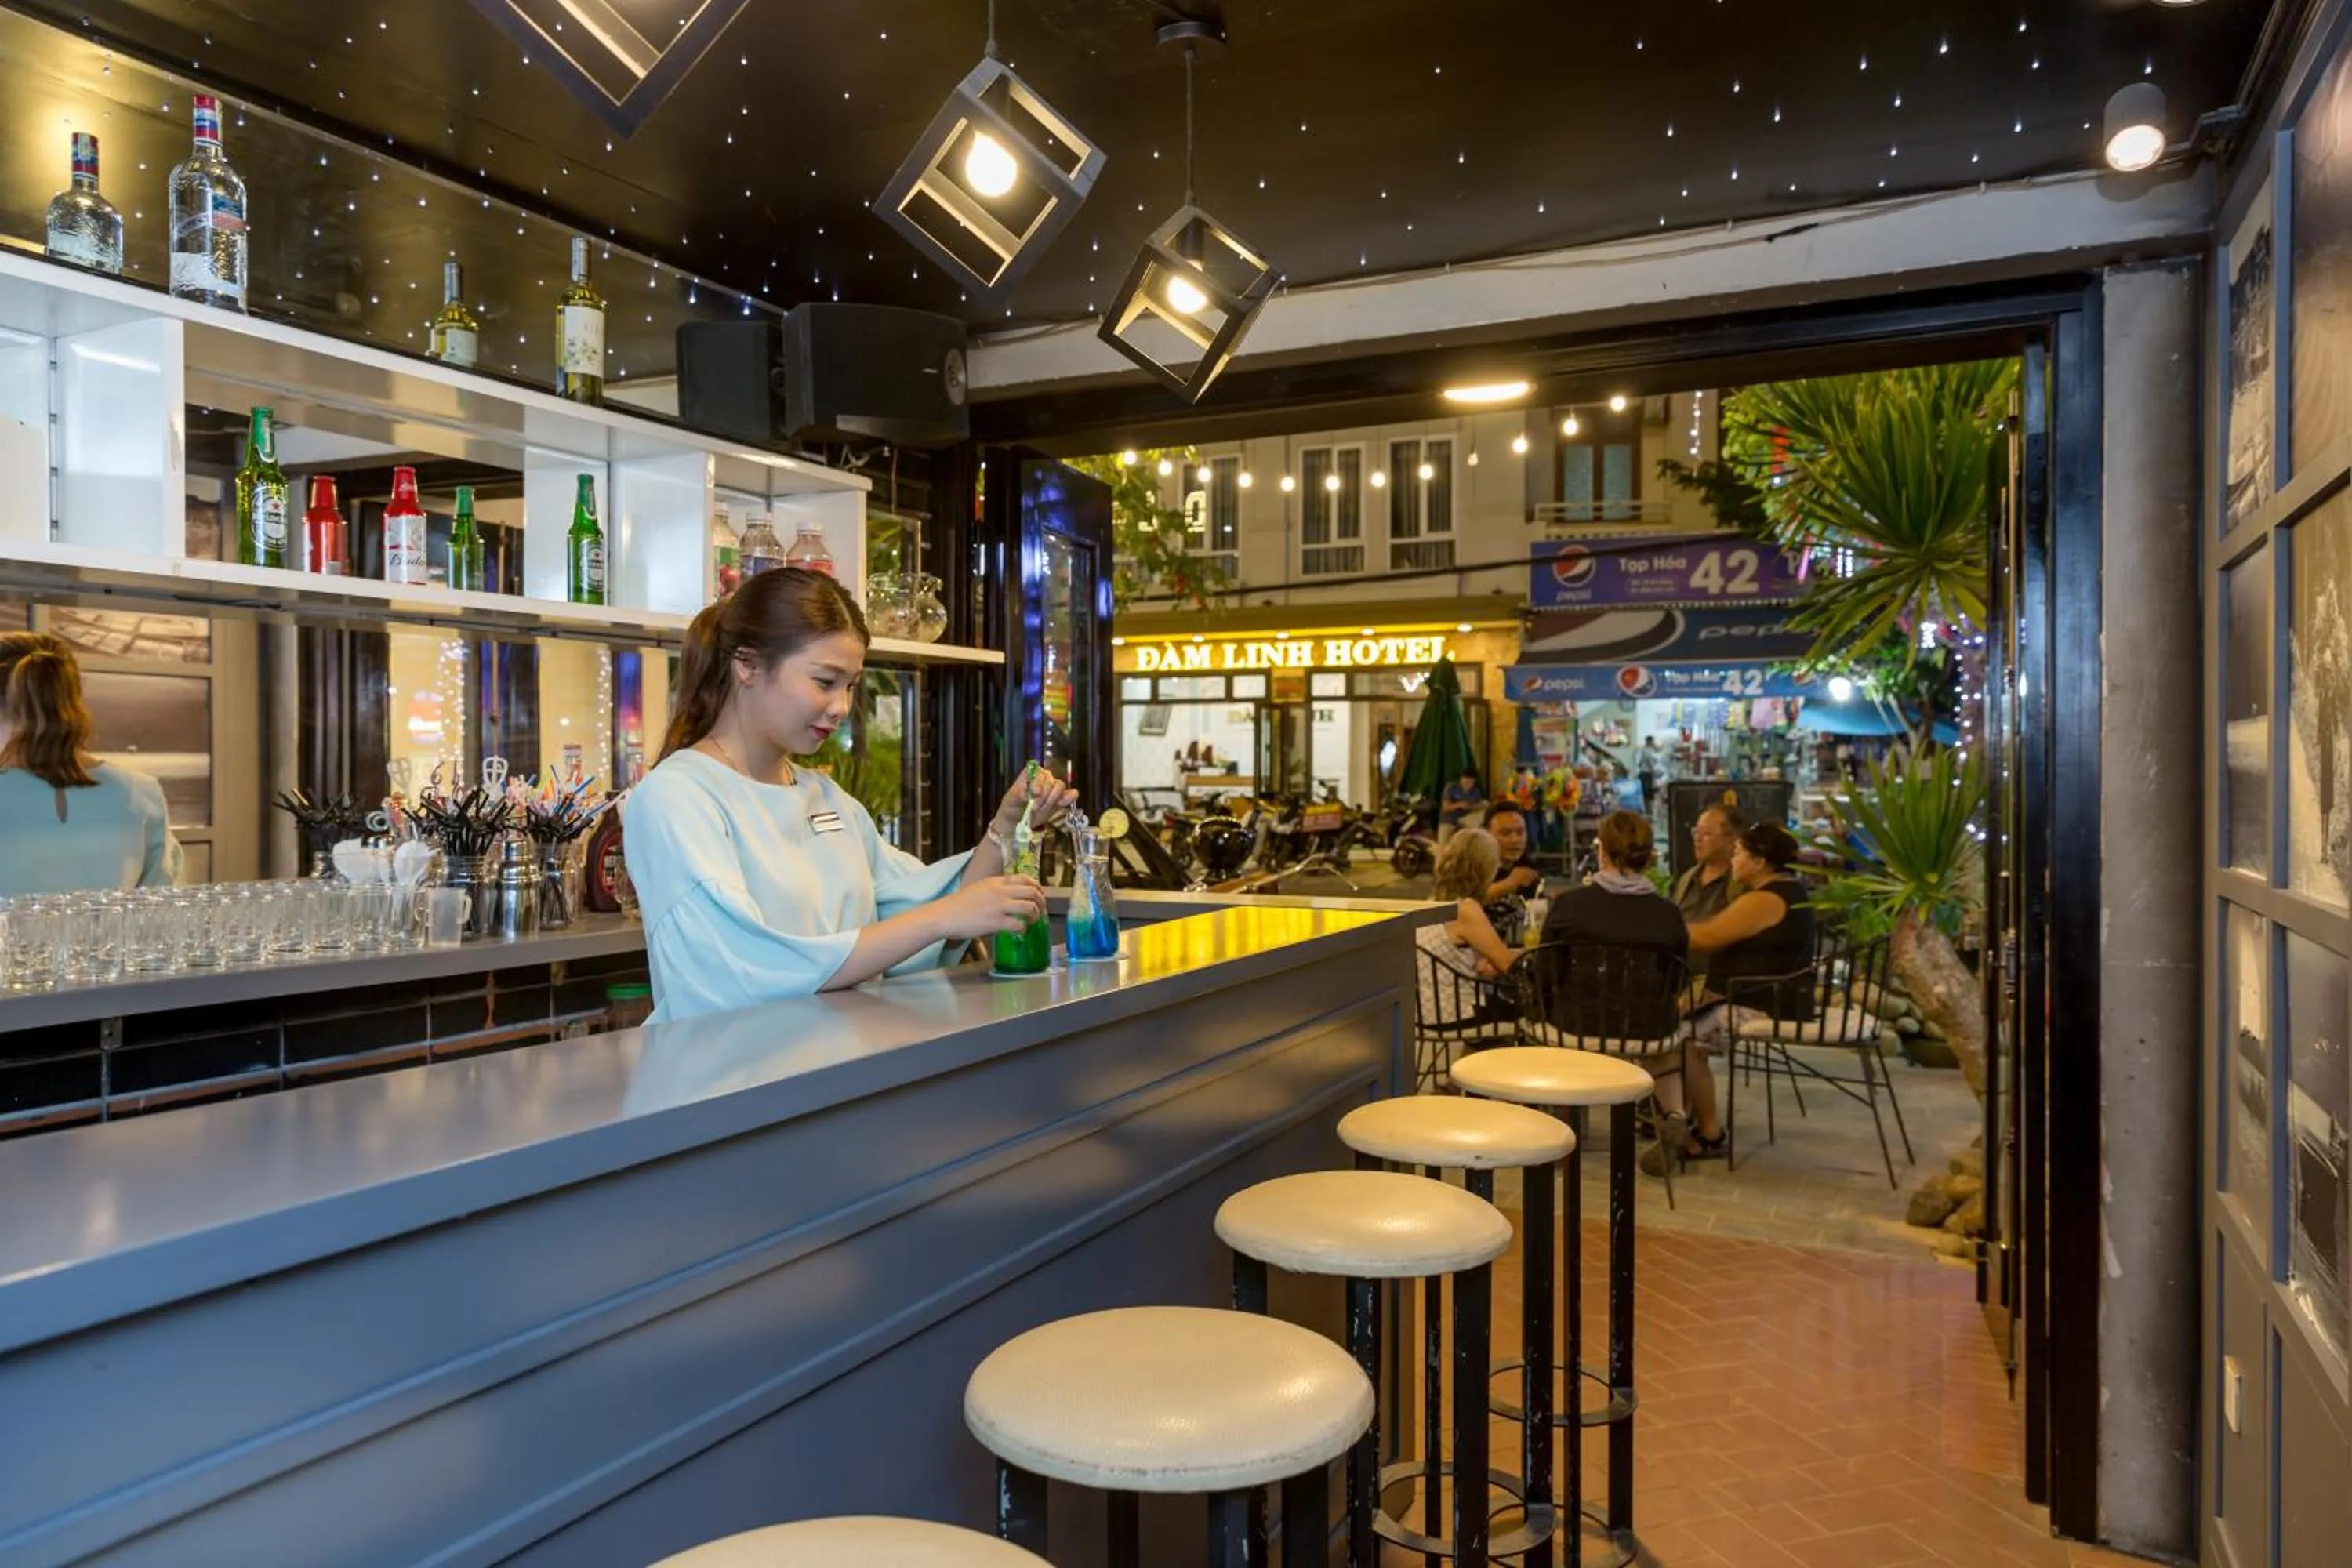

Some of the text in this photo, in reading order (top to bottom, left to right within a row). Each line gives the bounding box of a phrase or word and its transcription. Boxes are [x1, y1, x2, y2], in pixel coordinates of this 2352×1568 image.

[1689, 550, 1759, 594] 42
[1222, 640, 1314, 668] LINH
[1544, 677, 1584, 692] pepsi
[1722, 668, 1763, 696] 42
